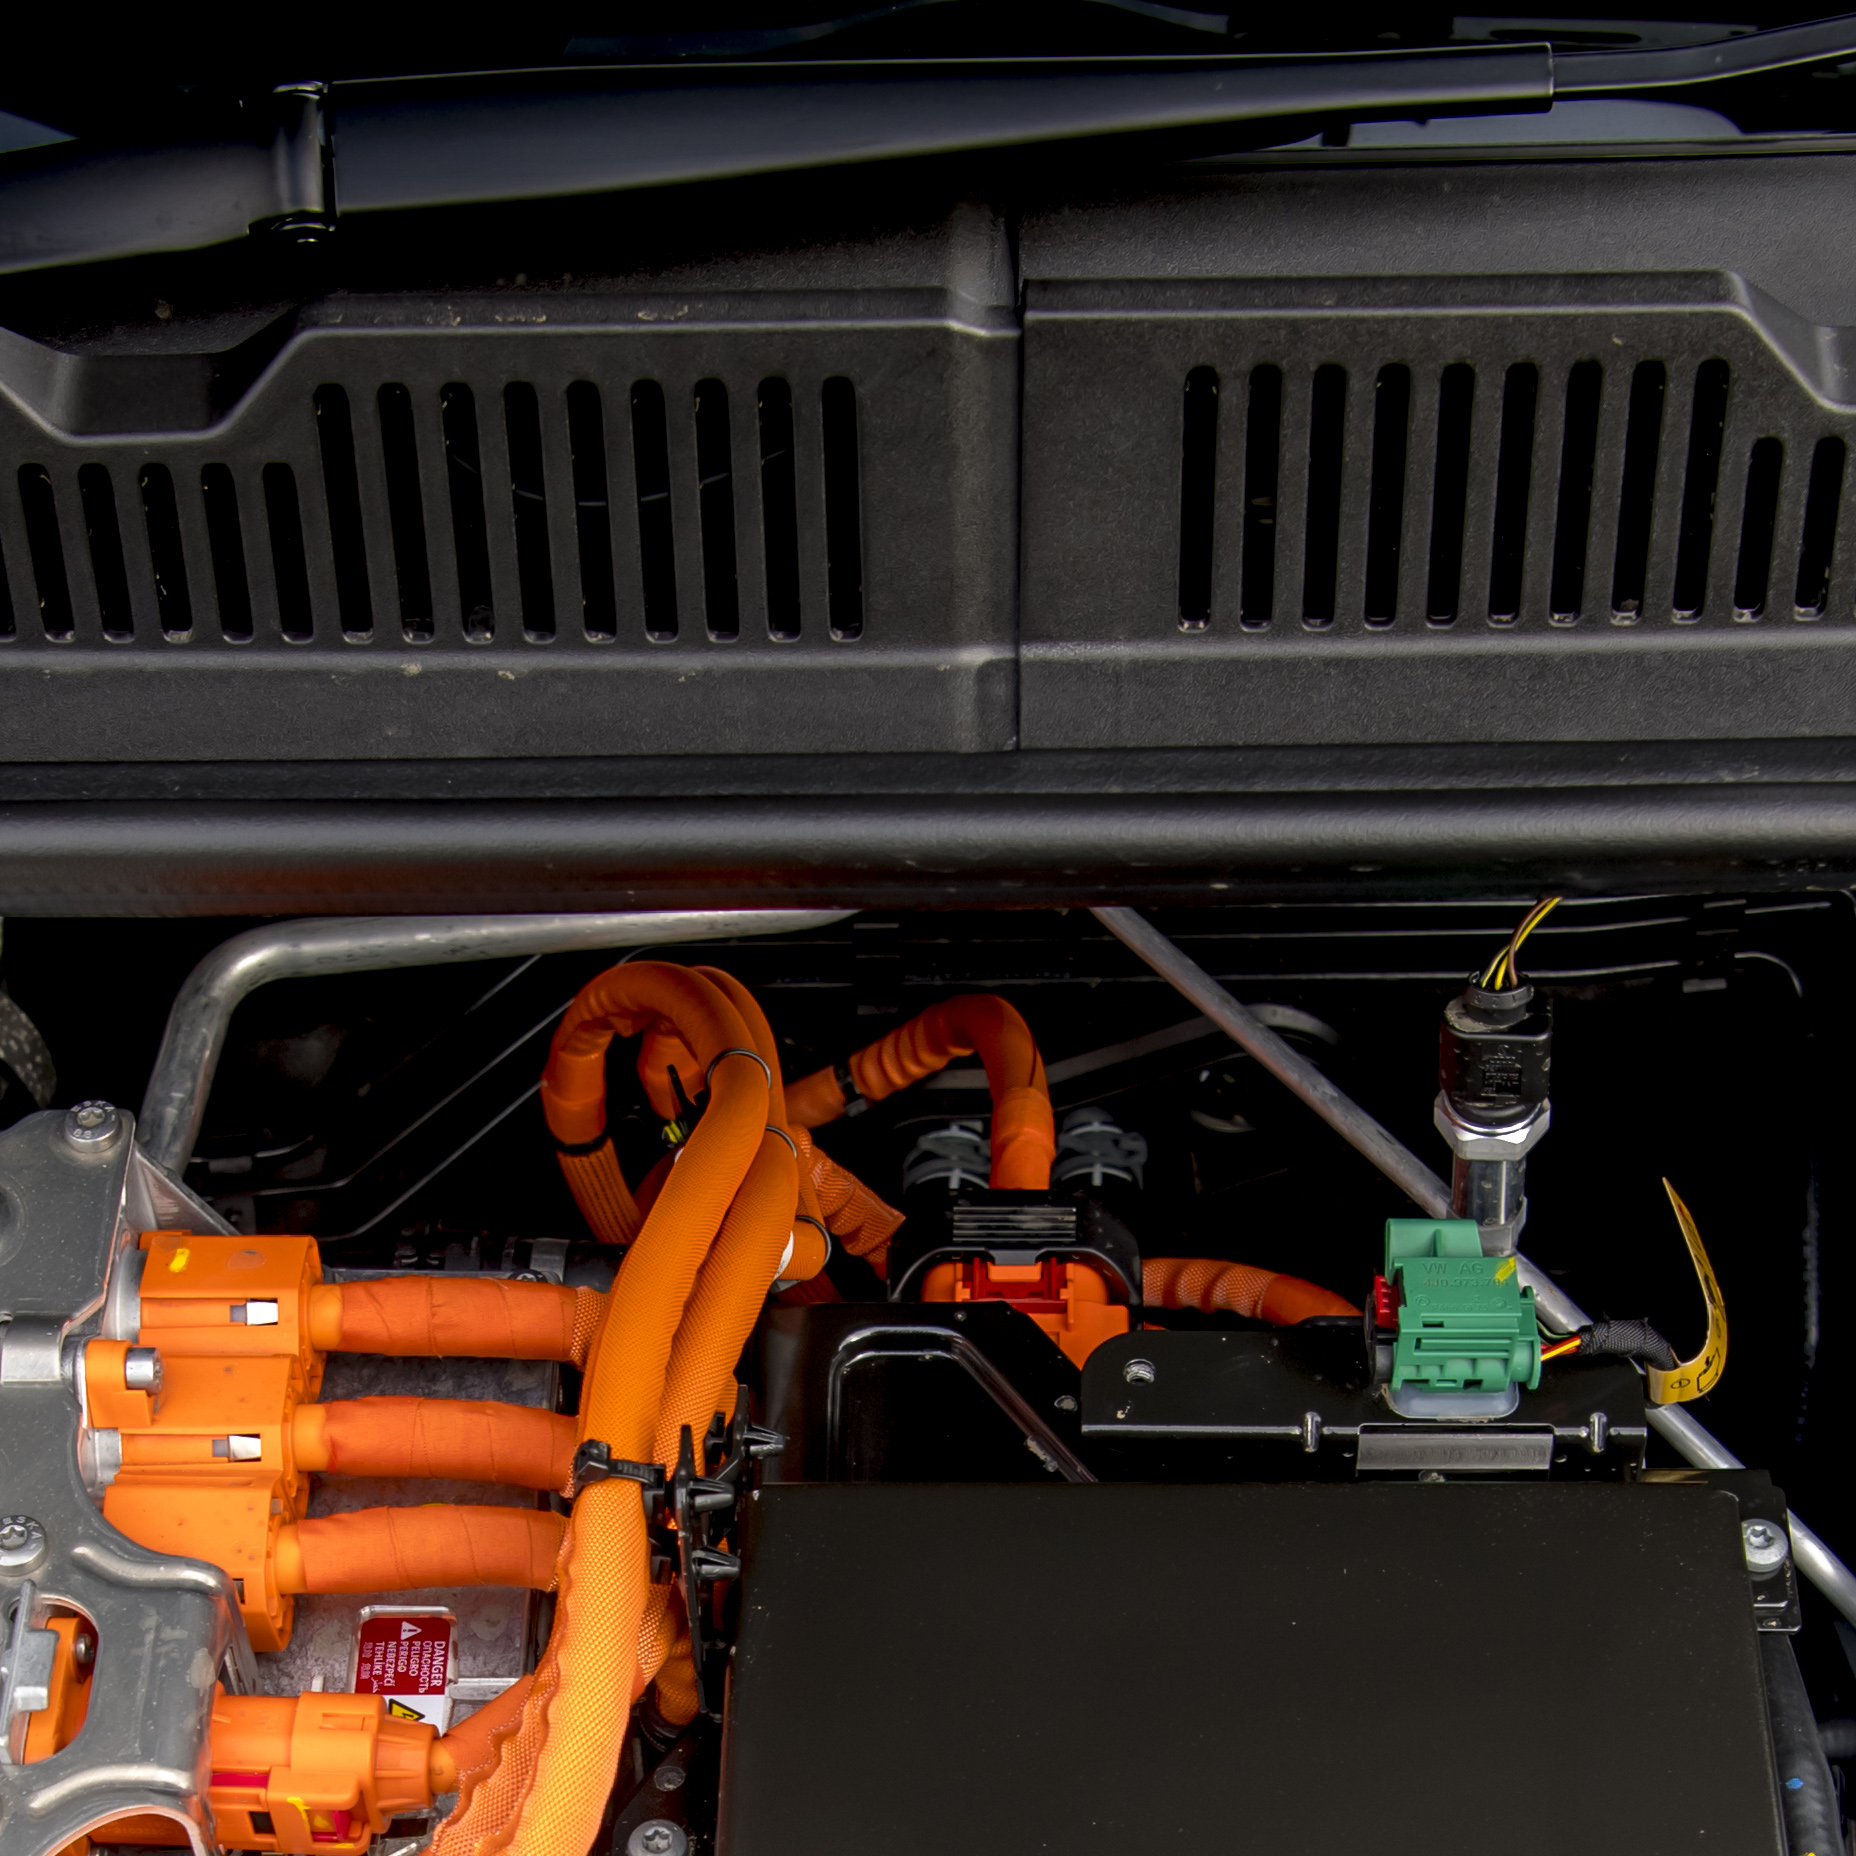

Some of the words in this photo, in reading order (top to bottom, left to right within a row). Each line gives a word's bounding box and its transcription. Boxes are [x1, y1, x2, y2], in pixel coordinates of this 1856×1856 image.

[1422, 1262, 1447, 1275] VW
[1459, 1262, 1484, 1275] AG
[397, 1640, 409, 1673] PERIGO
[408, 1640, 421, 1677] PELIGRO
[430, 1640, 446, 1687] DANGER
